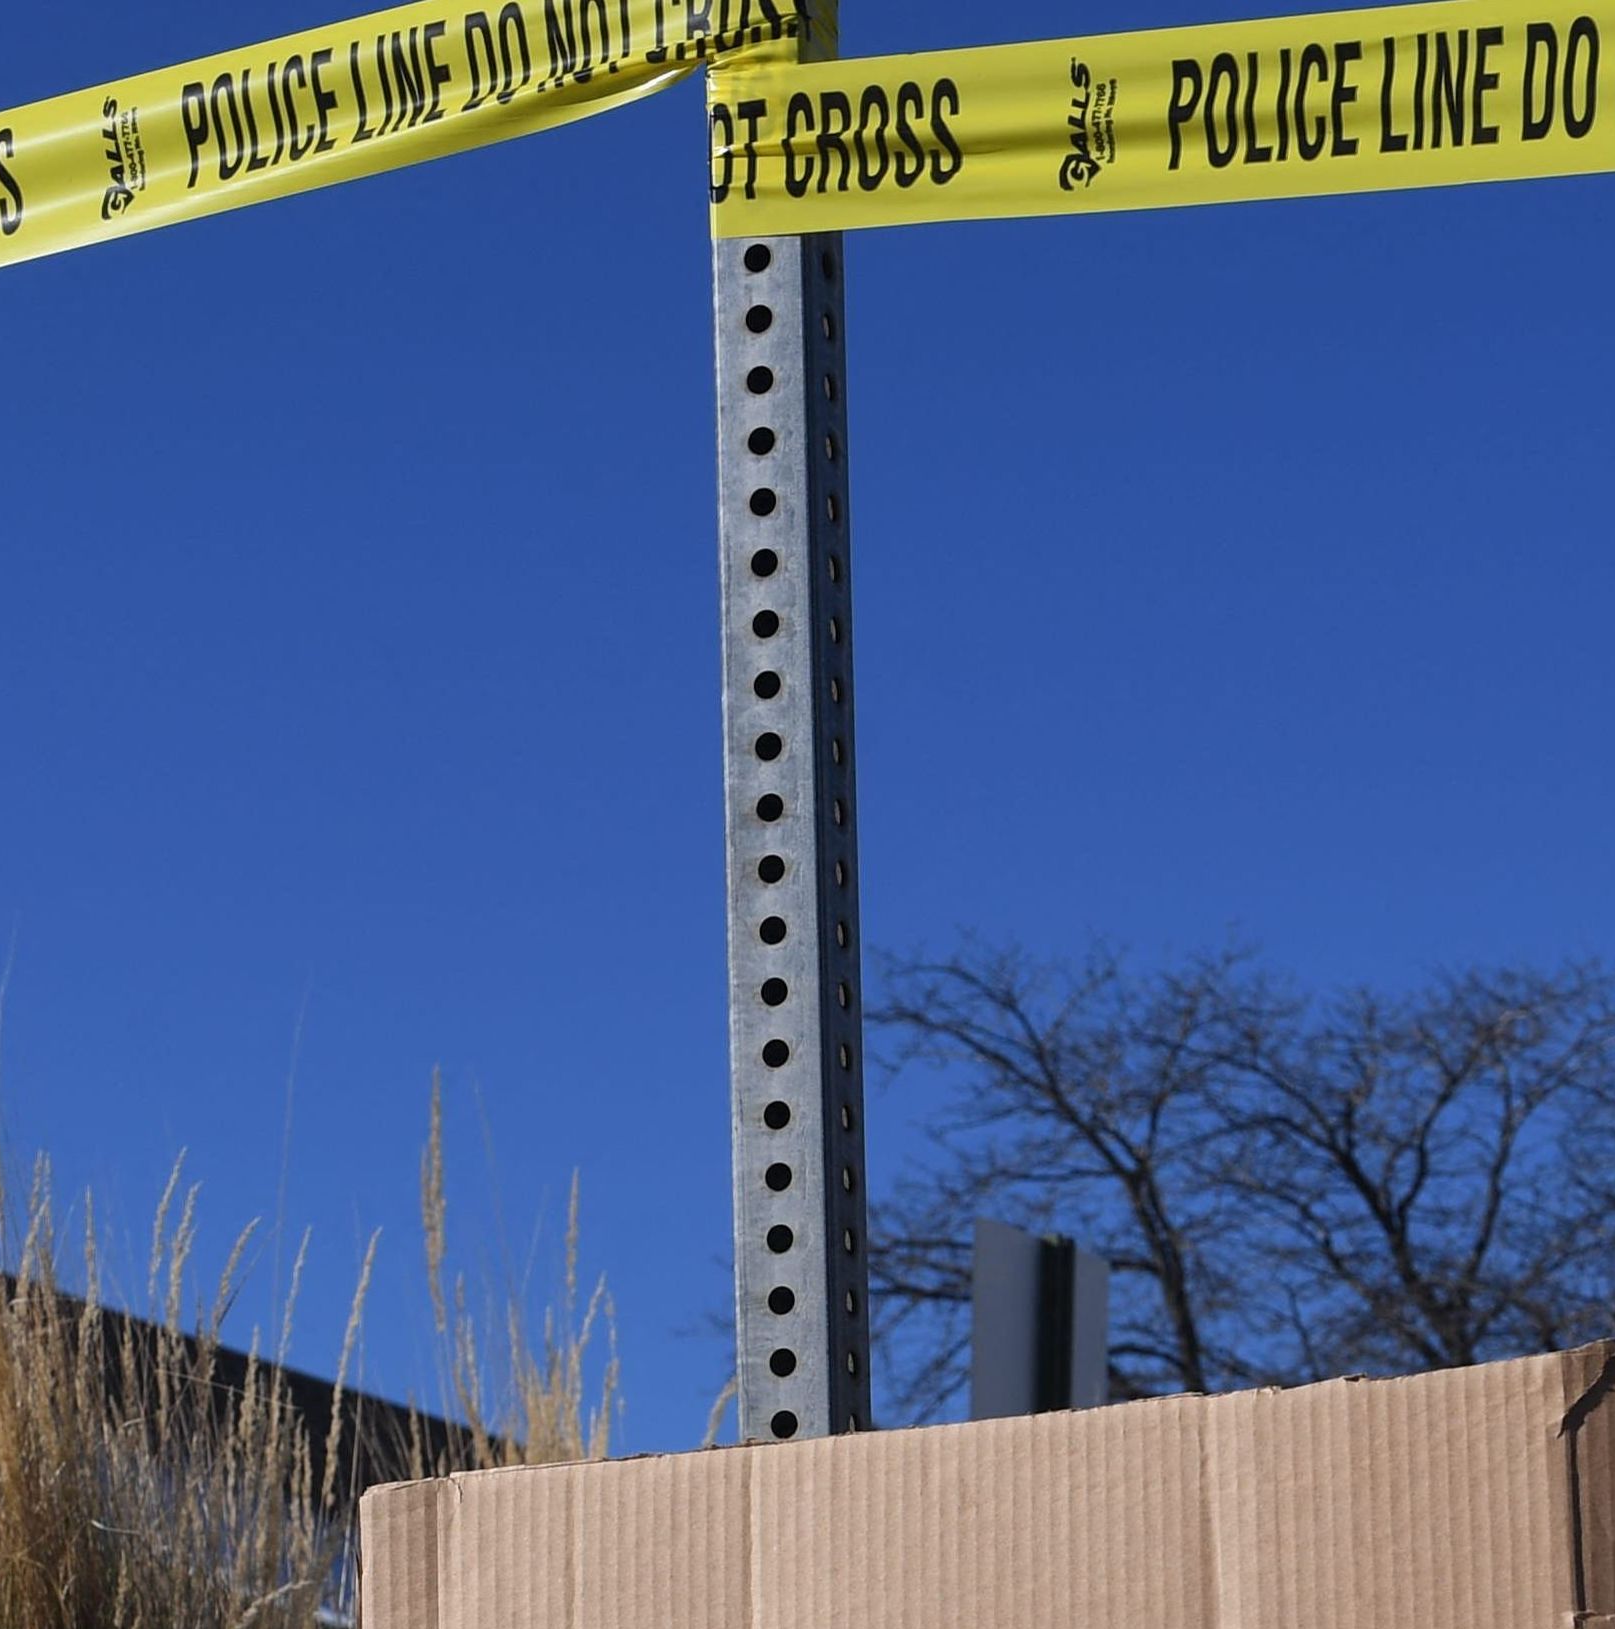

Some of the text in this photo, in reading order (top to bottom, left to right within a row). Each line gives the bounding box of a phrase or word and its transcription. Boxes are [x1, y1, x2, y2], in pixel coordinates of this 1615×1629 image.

[102, 96, 135, 219] GALLS
[181, 48, 338, 188] POLICE
[350, 20, 451, 143] LINE
[462, 1, 531, 112] DO
[538, 0, 631, 92] NOT
[710, 78, 963, 204] OT CROSS
[1059, 57, 1101, 191] GALLS
[1168, 41, 1362, 170] POLICE
[1380, 26, 1504, 153] LINE
[1522, 16, 1599, 141] DO
